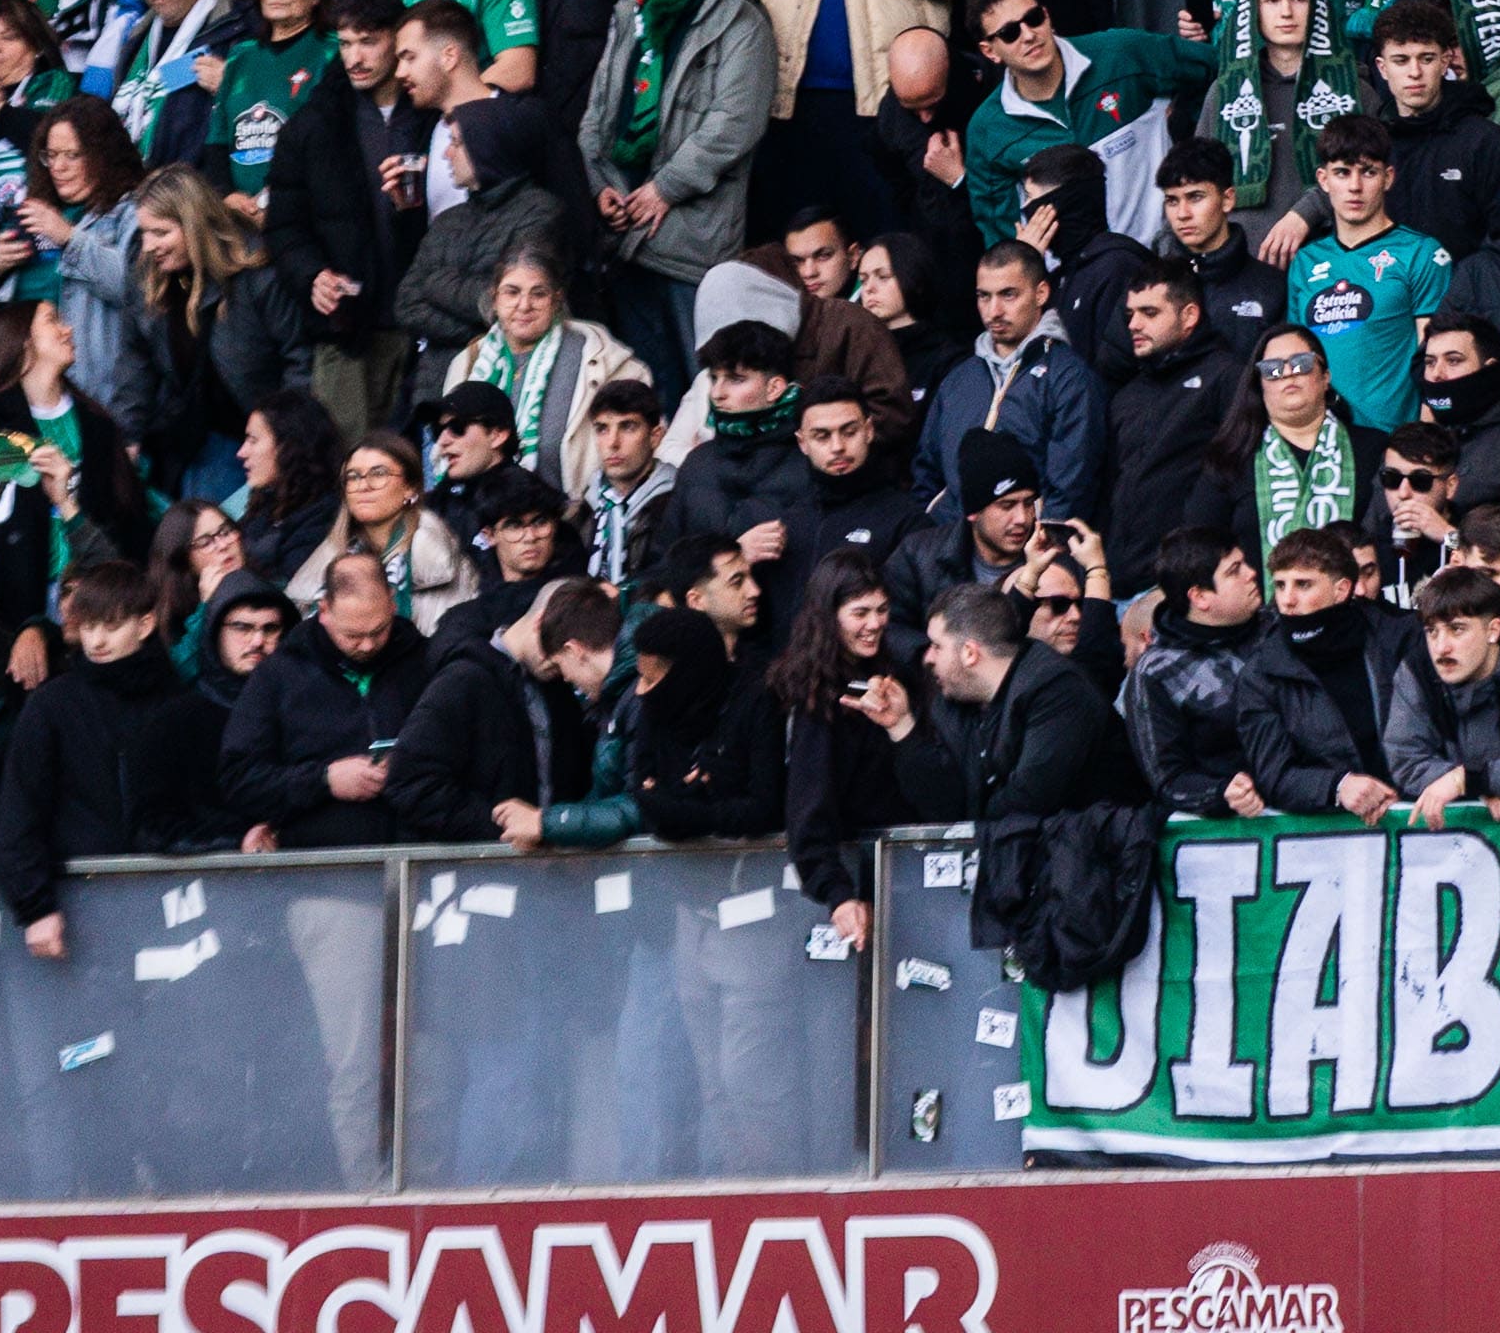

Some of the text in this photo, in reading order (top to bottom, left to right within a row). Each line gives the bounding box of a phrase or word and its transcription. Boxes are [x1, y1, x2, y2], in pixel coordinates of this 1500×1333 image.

[1314, 291, 1363, 310] Estrella
[1314, 306, 1359, 324] Galicia
[1118, 1284, 1345, 1333] PESCAMAR
